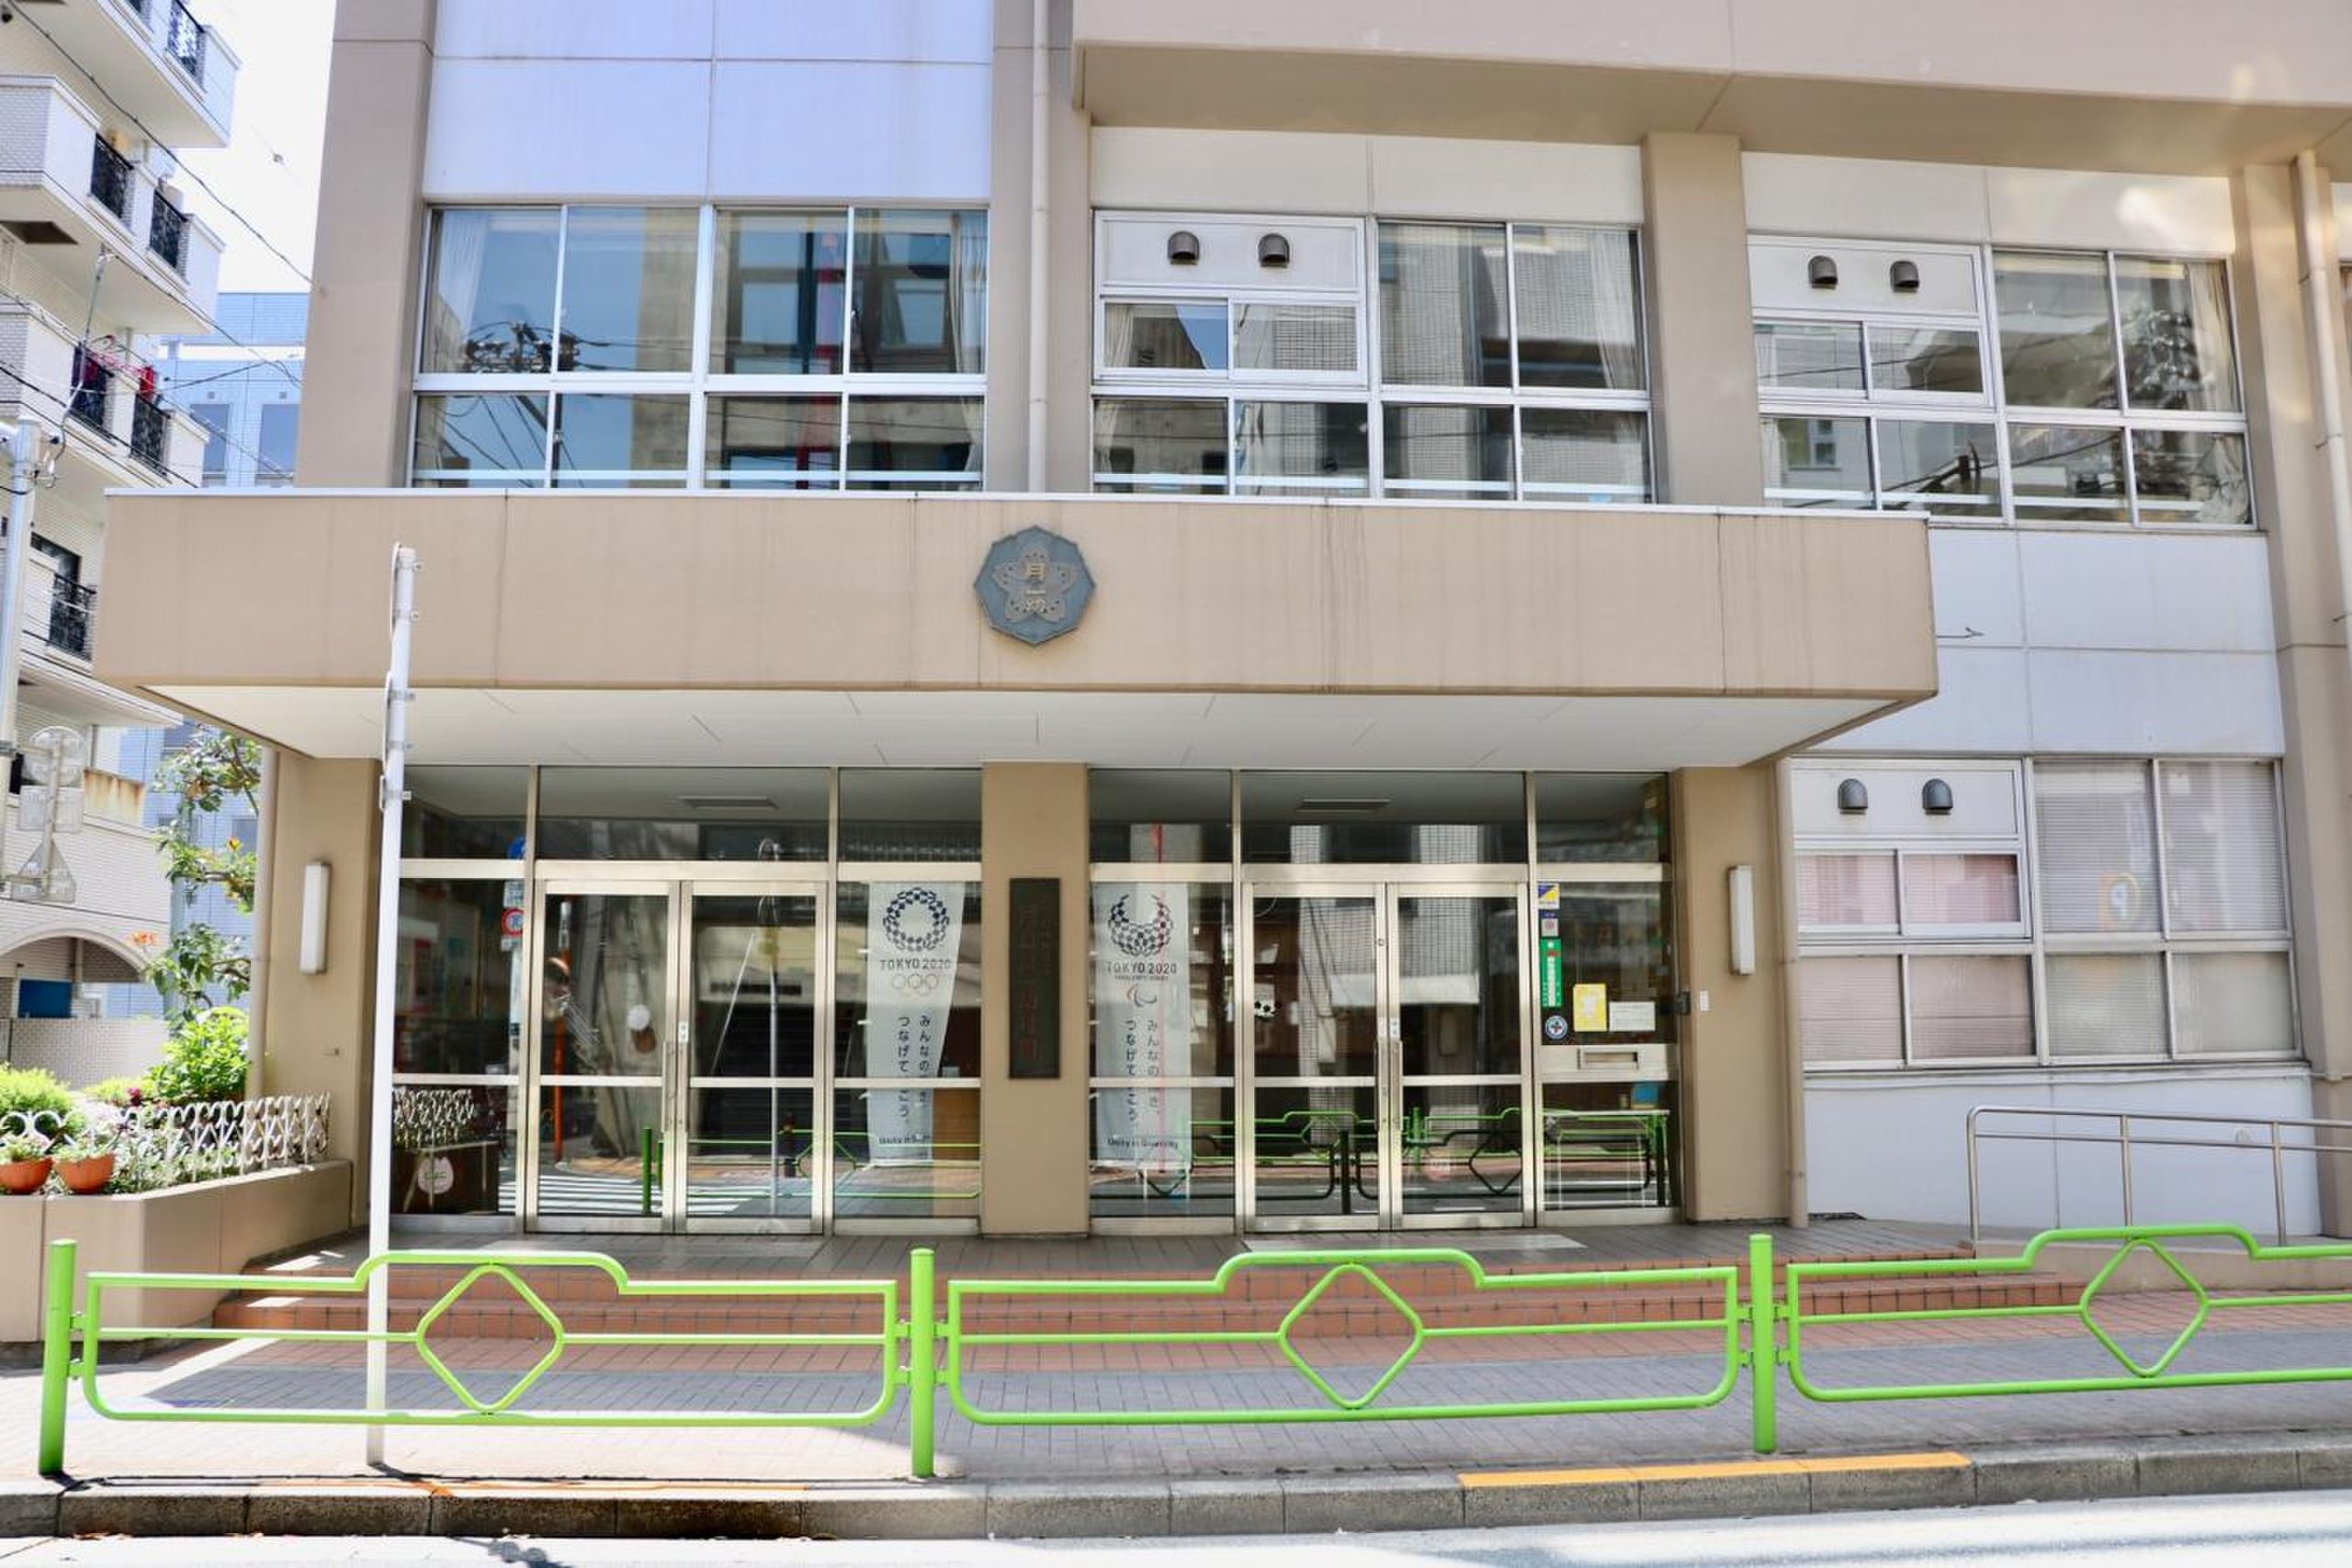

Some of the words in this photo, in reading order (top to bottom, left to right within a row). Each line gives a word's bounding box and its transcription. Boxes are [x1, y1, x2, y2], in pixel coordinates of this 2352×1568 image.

[879, 958, 920, 970] TOKYO
[922, 958, 952, 970] 2020
[1105, 961, 1146, 974] TOKYO
[1148, 962, 1178, 974] 2020
